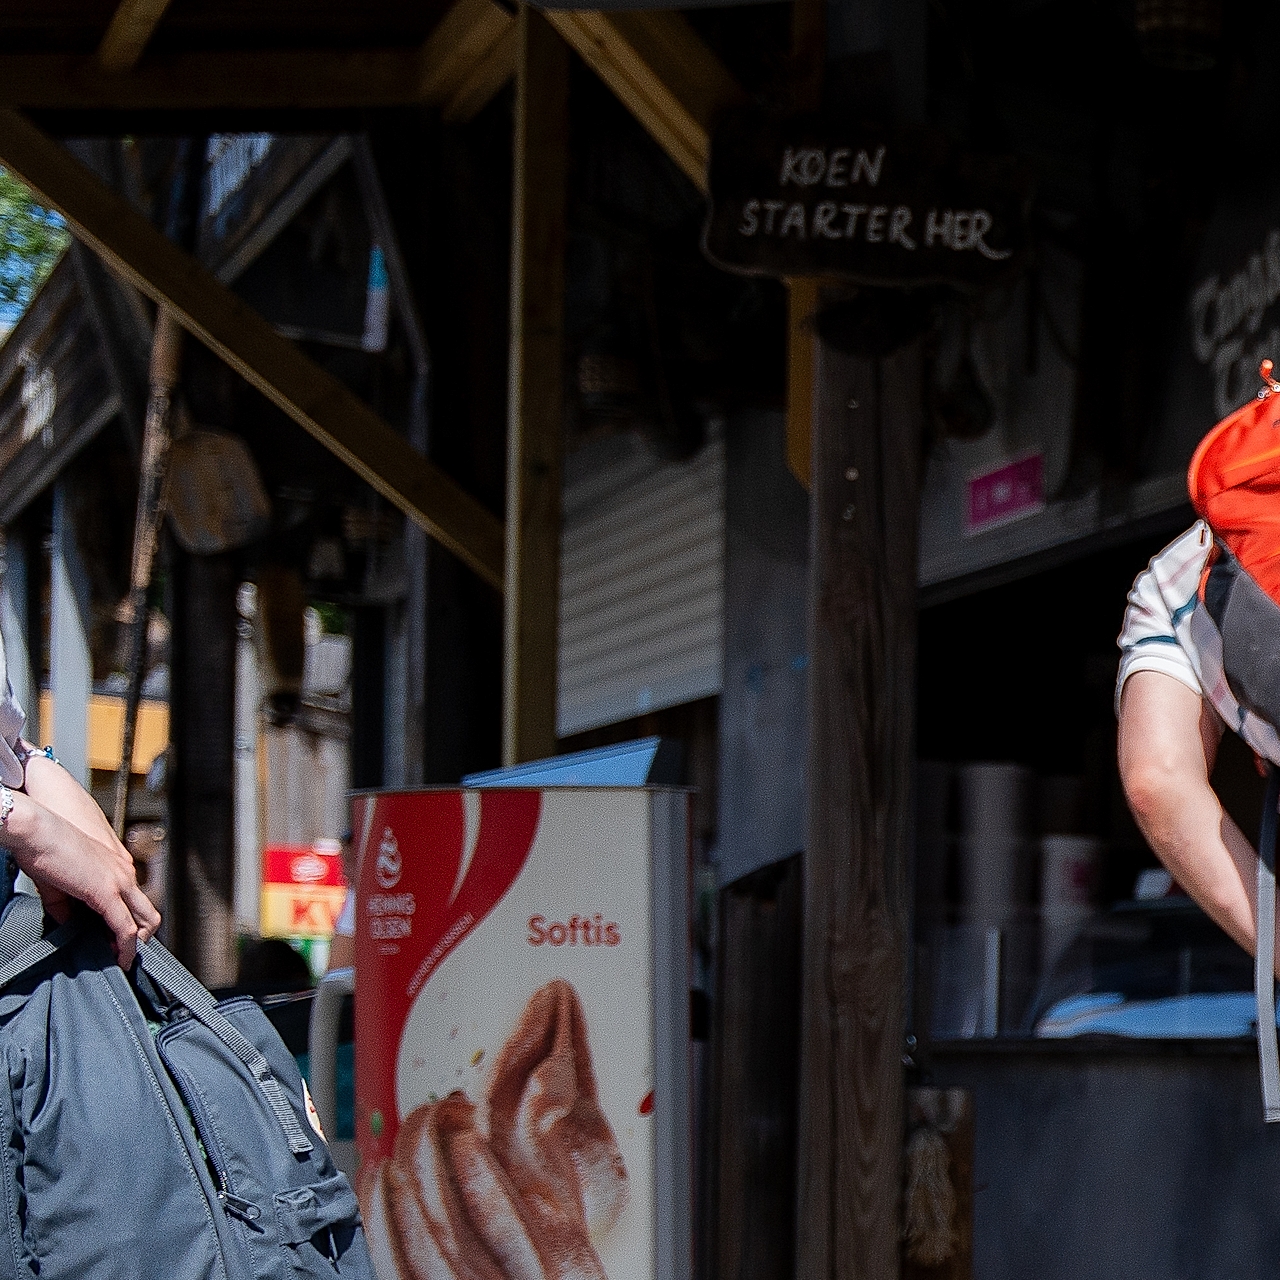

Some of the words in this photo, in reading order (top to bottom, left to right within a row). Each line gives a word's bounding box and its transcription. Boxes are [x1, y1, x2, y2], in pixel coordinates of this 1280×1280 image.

[739, 200, 916, 250] STARTER
[925, 208, 1013, 260] HER
[527, 912, 621, 946] Softis
